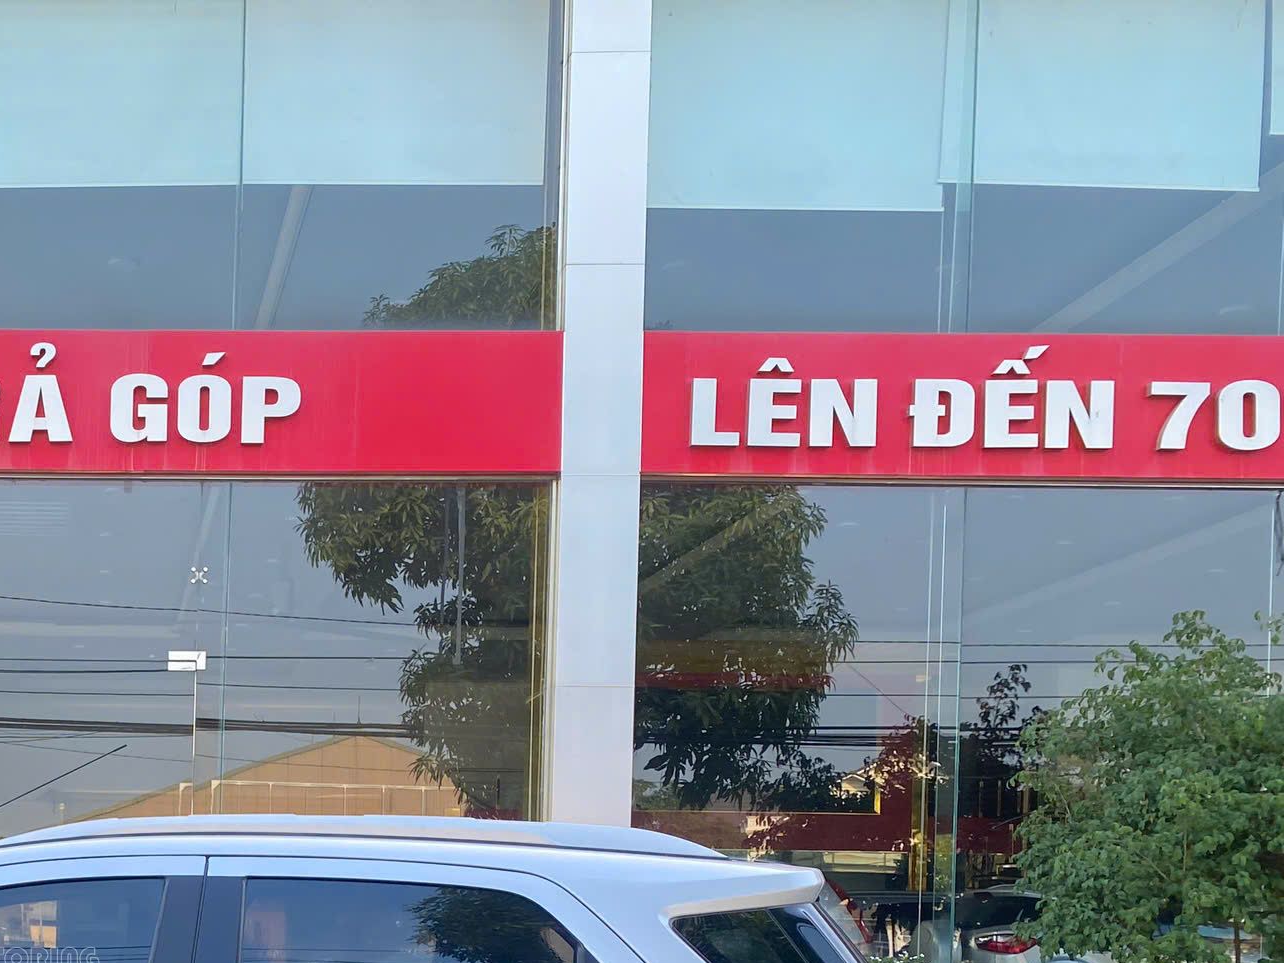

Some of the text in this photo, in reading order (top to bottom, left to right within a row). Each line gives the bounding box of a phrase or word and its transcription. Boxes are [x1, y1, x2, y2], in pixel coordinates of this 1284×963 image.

[109, 351, 302, 444] GÓP
[690, 344, 1281, 451] LÊN ĐẾN 70
